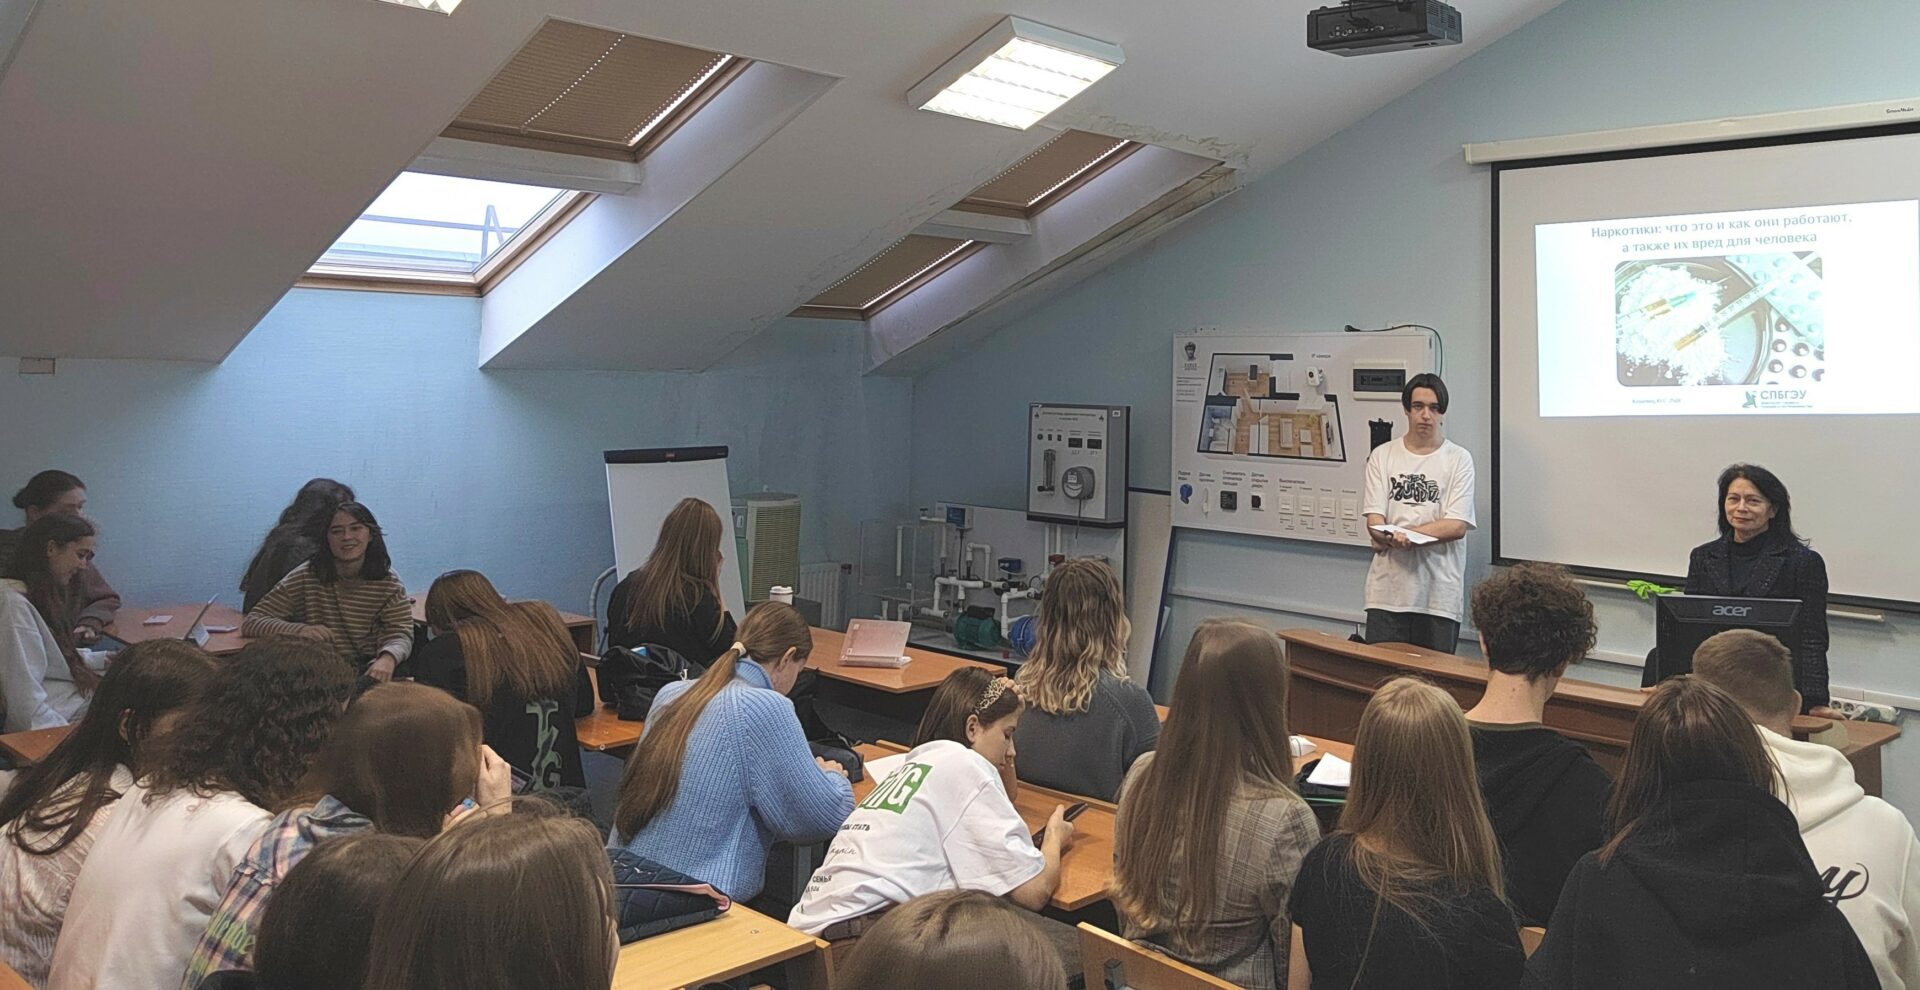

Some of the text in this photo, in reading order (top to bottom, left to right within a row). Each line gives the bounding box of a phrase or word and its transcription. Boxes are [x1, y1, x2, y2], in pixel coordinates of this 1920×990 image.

[1591, 226, 1662, 239] Наркотики:
[1666, 223, 1688, 233] что
[1691, 222, 1713, 232] это
[1717, 221, 1725, 230] и
[1729, 219, 1752, 230] как
[1754, 218, 1780, 228] они
[1622, 233, 1817, 253] а также их вред для человека
[1760, 390, 1807, 400] СПБГЭУ
[1712, 605, 1753, 617] acer
